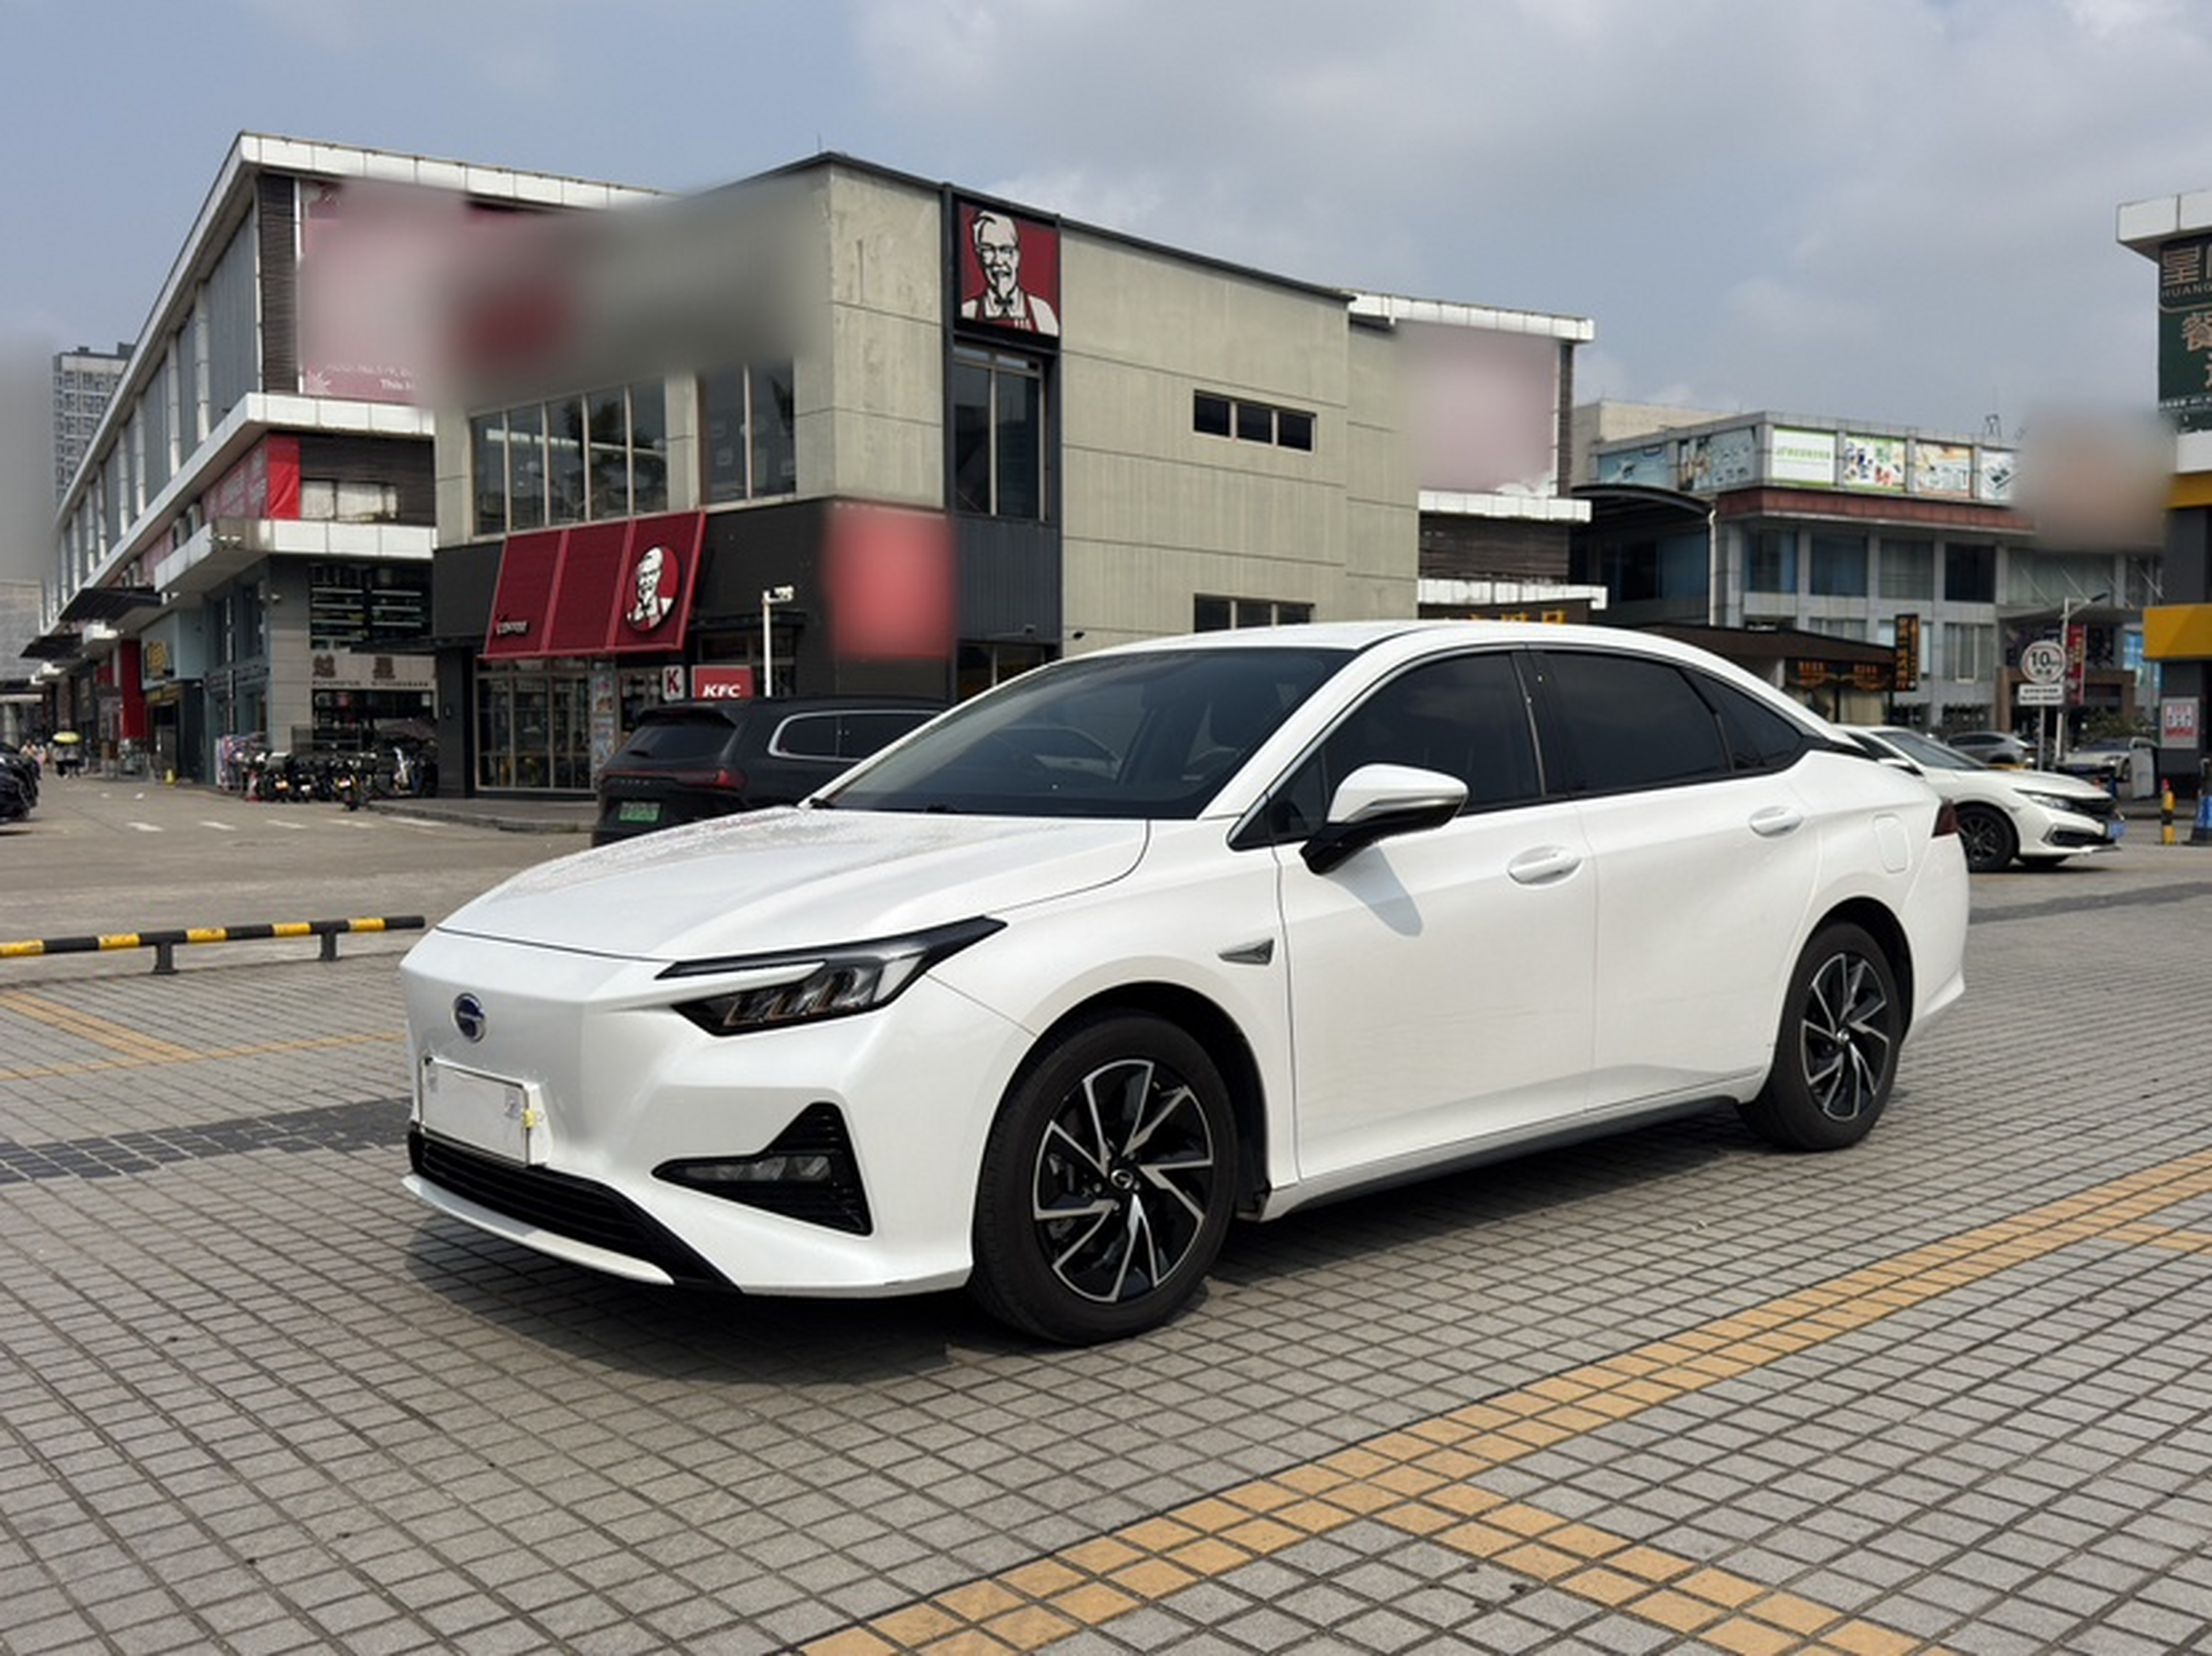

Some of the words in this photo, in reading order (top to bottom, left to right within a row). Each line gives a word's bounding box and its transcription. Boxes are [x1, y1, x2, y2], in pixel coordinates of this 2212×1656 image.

[2032, 650, 2051, 668] 10
[666, 669, 680, 694] K
[702, 683, 741, 699] KFC
